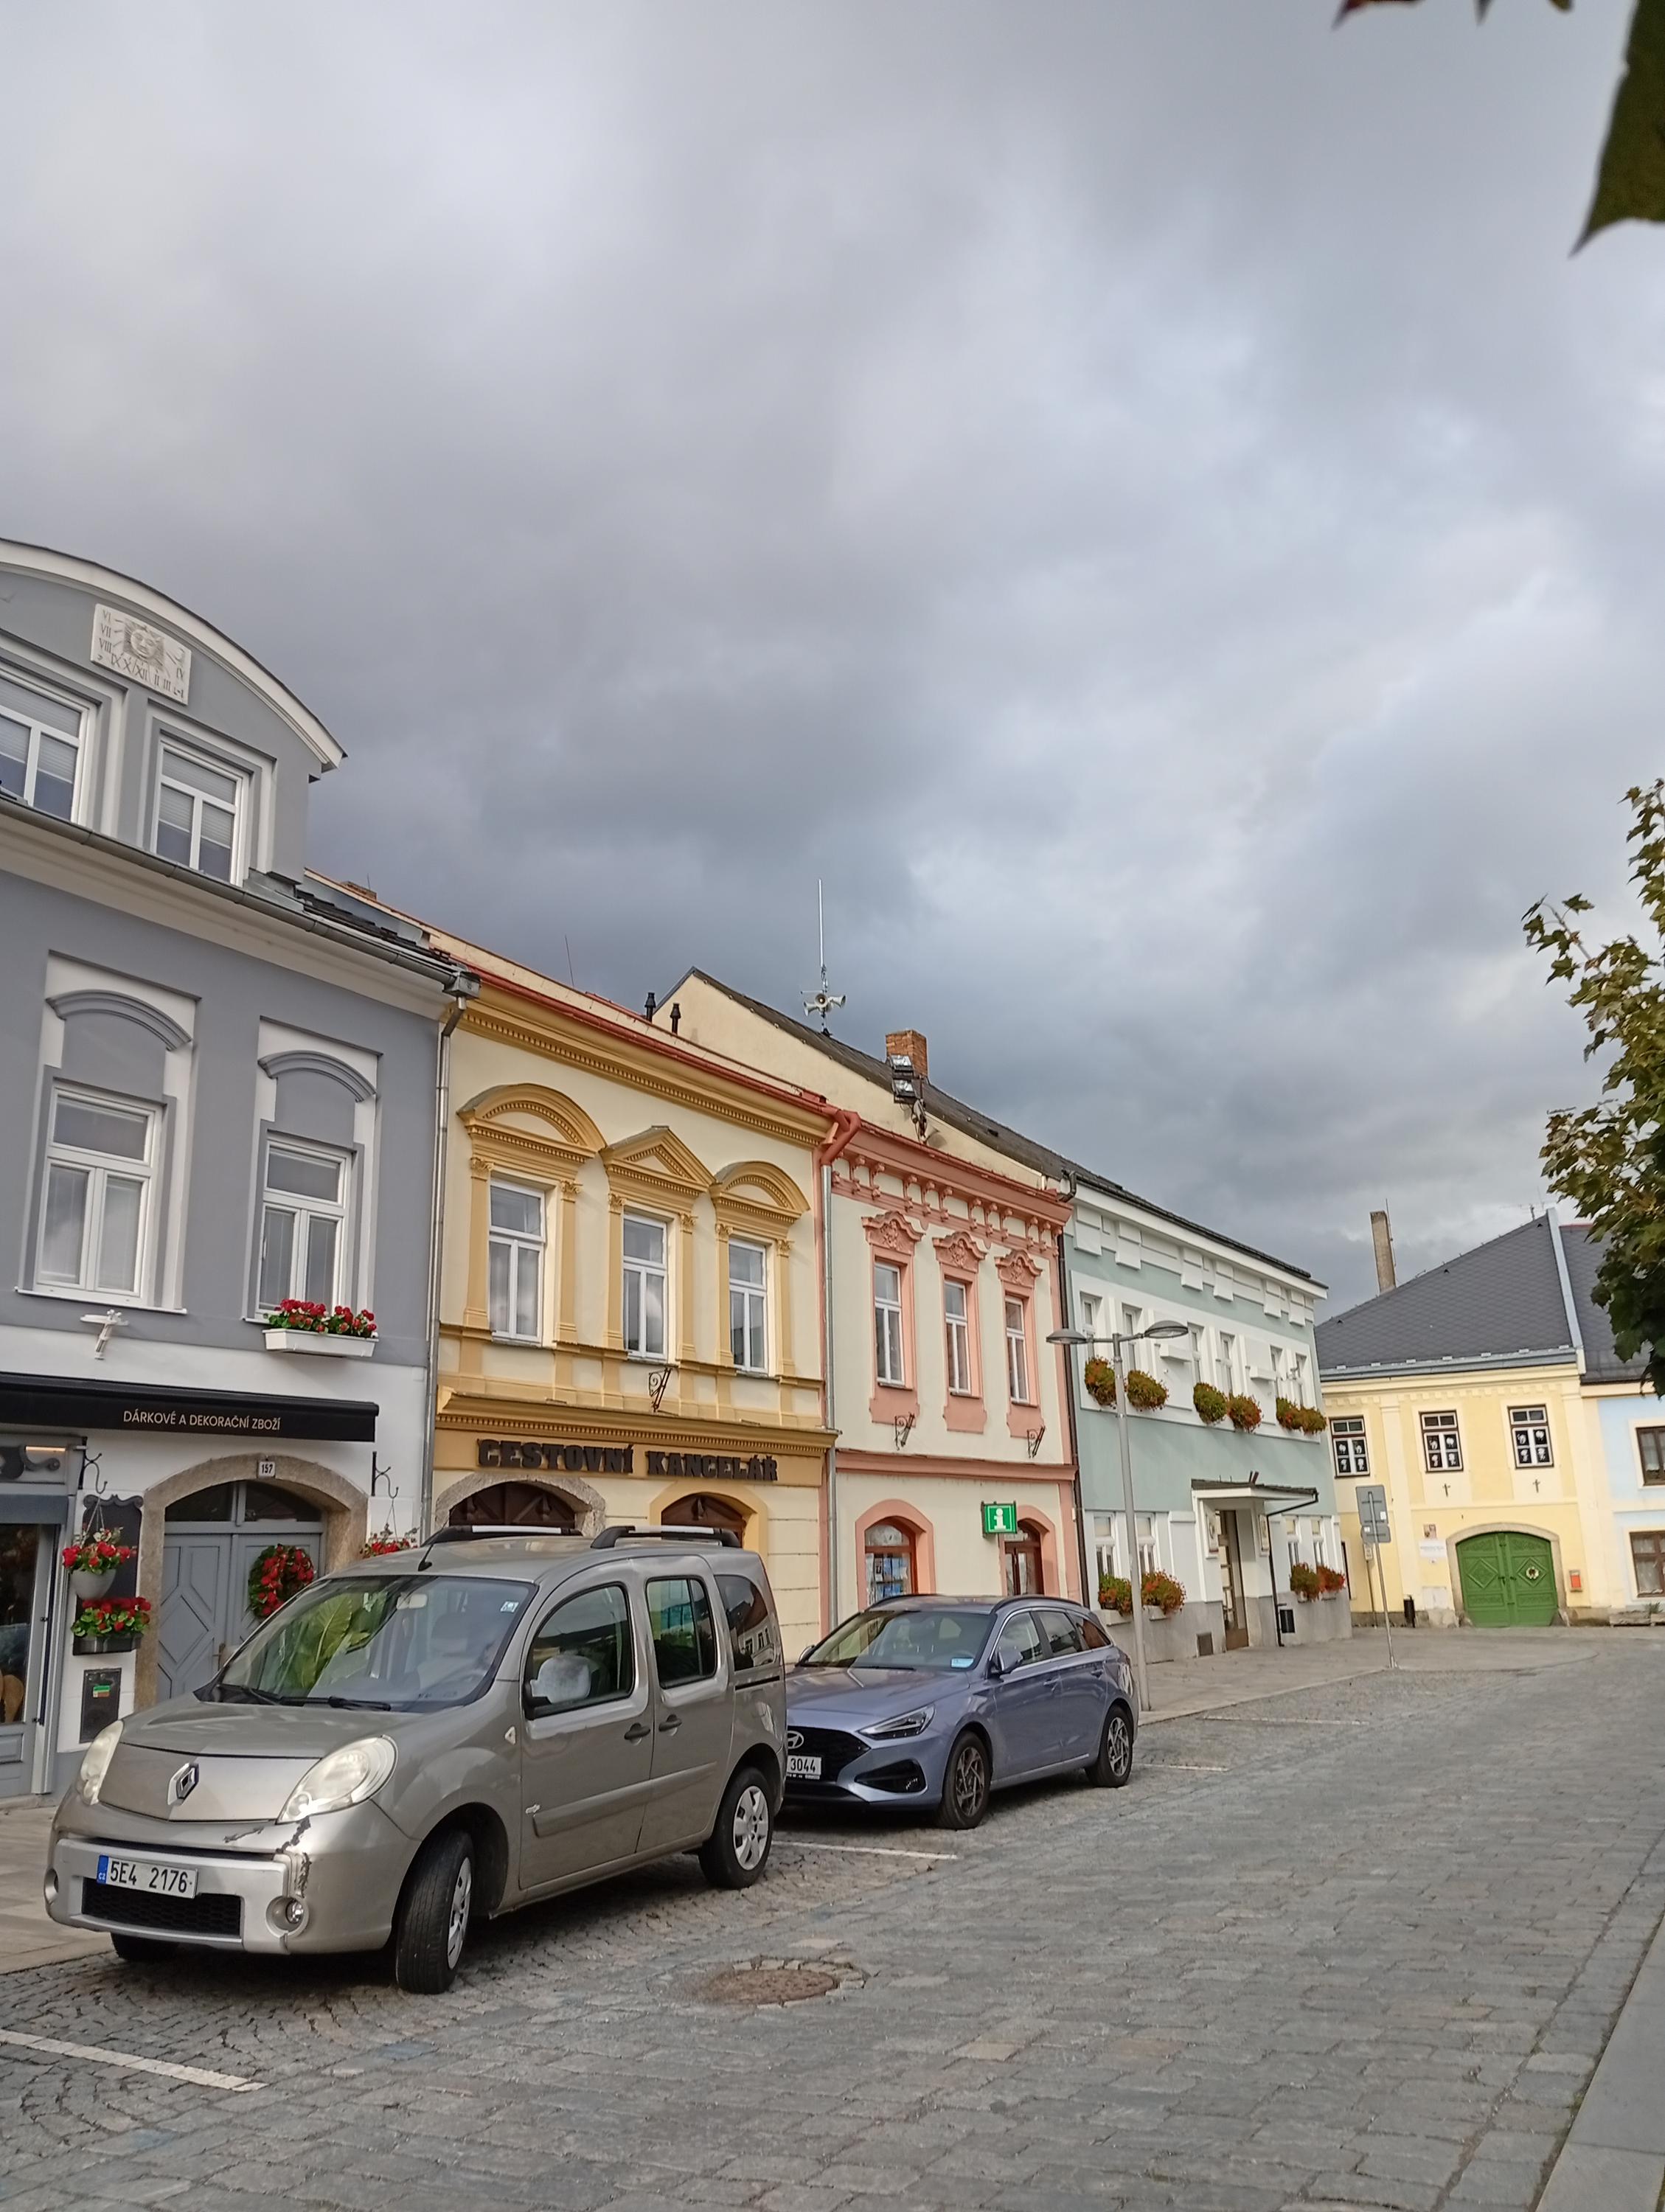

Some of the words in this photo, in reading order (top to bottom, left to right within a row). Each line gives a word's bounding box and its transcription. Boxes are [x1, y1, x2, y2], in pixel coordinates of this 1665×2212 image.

[102, 609, 111, 623] VI
[100, 623, 111, 639] VII
[99, 637, 112, 654] VIII
[123, 1408, 175, 1425] DÁRKOVÉ
[178, 1413, 187, 1425] A
[189, 1415, 250, 1428] DEKORAČNÍ
[251, 1417, 281, 1430] ZBOŽÍ
[477, 1439, 634, 1475] CESTOVNÍ
[645, 1450, 779, 1481] KANCELÁŘ
[261, 1464, 274, 1474] 157
[790, 1758, 816, 1773] 3044
[110, 1860, 137, 1886] 5E4
[149, 1867, 188, 1893] 2176
